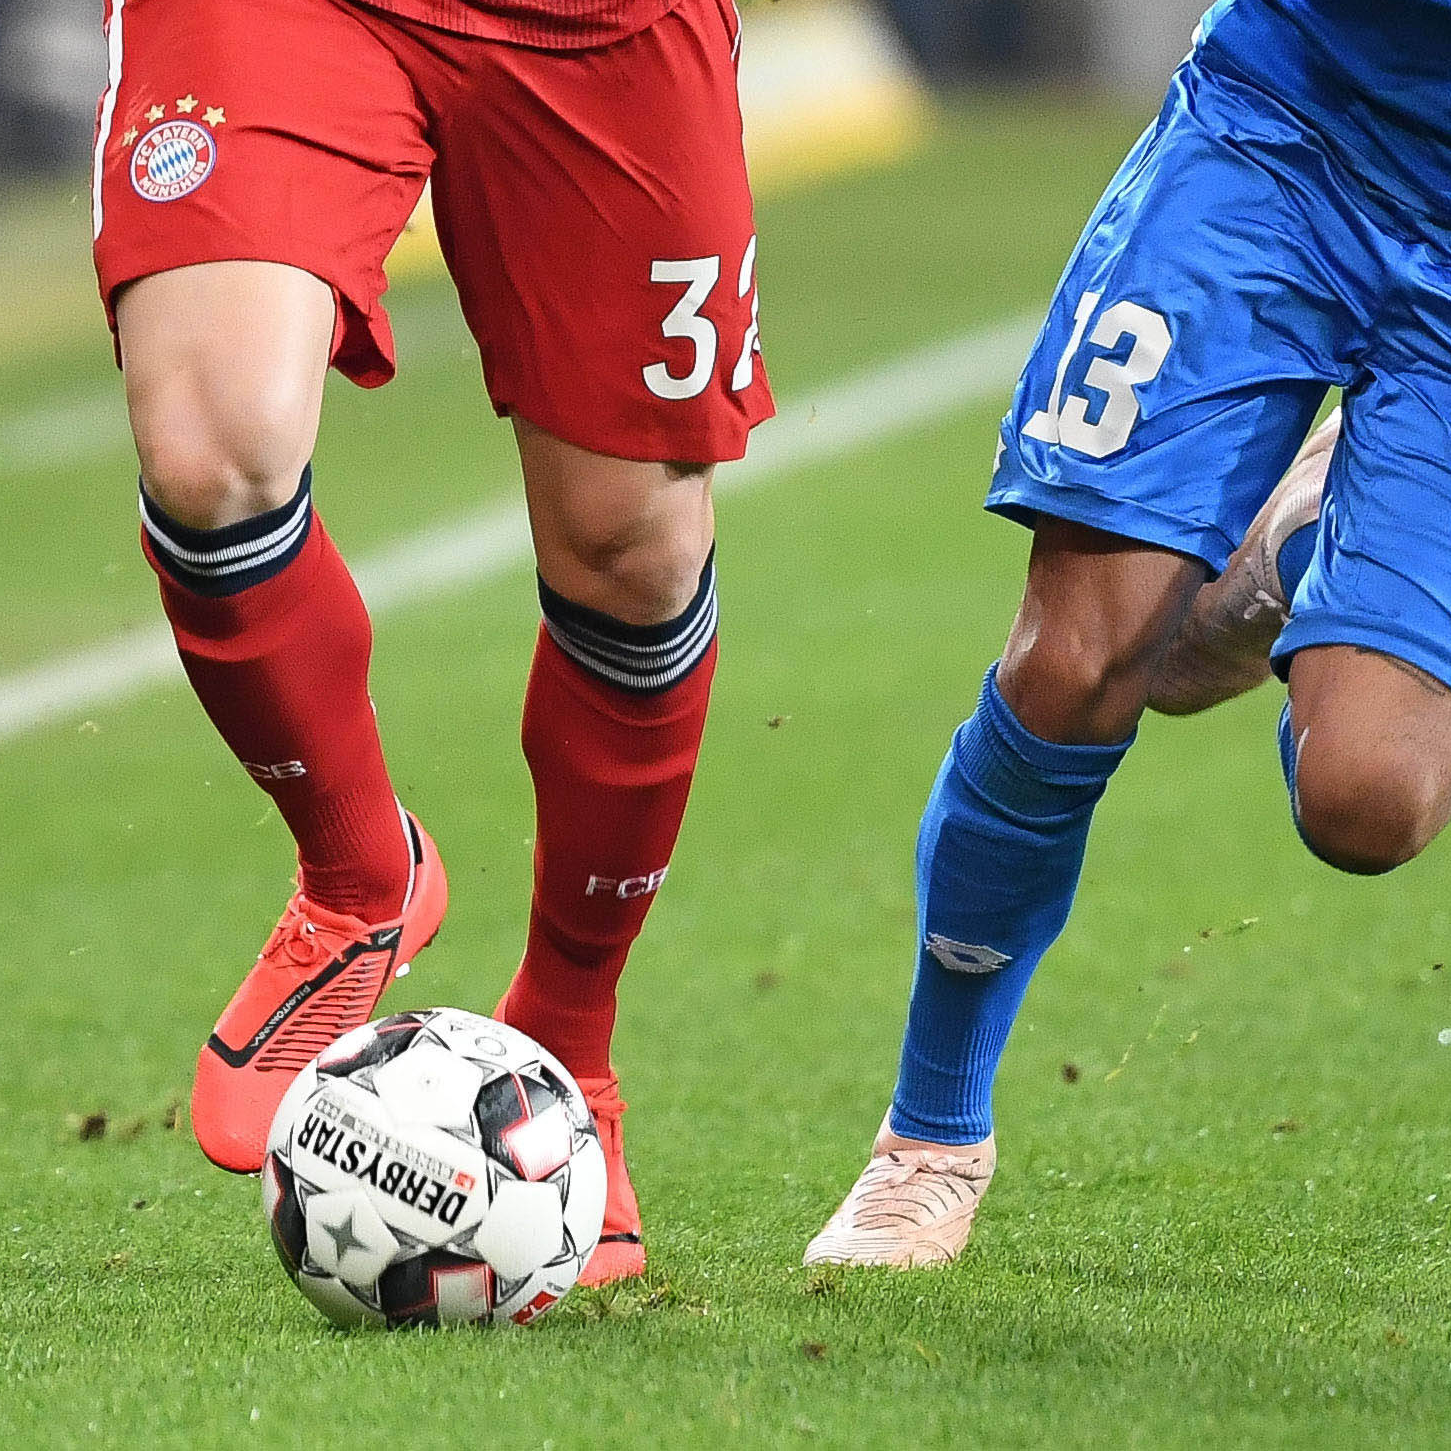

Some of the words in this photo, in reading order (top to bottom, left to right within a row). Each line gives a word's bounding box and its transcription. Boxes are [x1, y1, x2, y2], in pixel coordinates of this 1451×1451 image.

[136, 144, 153, 166] FC
[150, 126, 207, 151] BAYERN
[1020, 291, 1173, 459] 13
[243, 760, 306, 779] CB
[298, 1112, 469, 1227] DERBYSTAR
